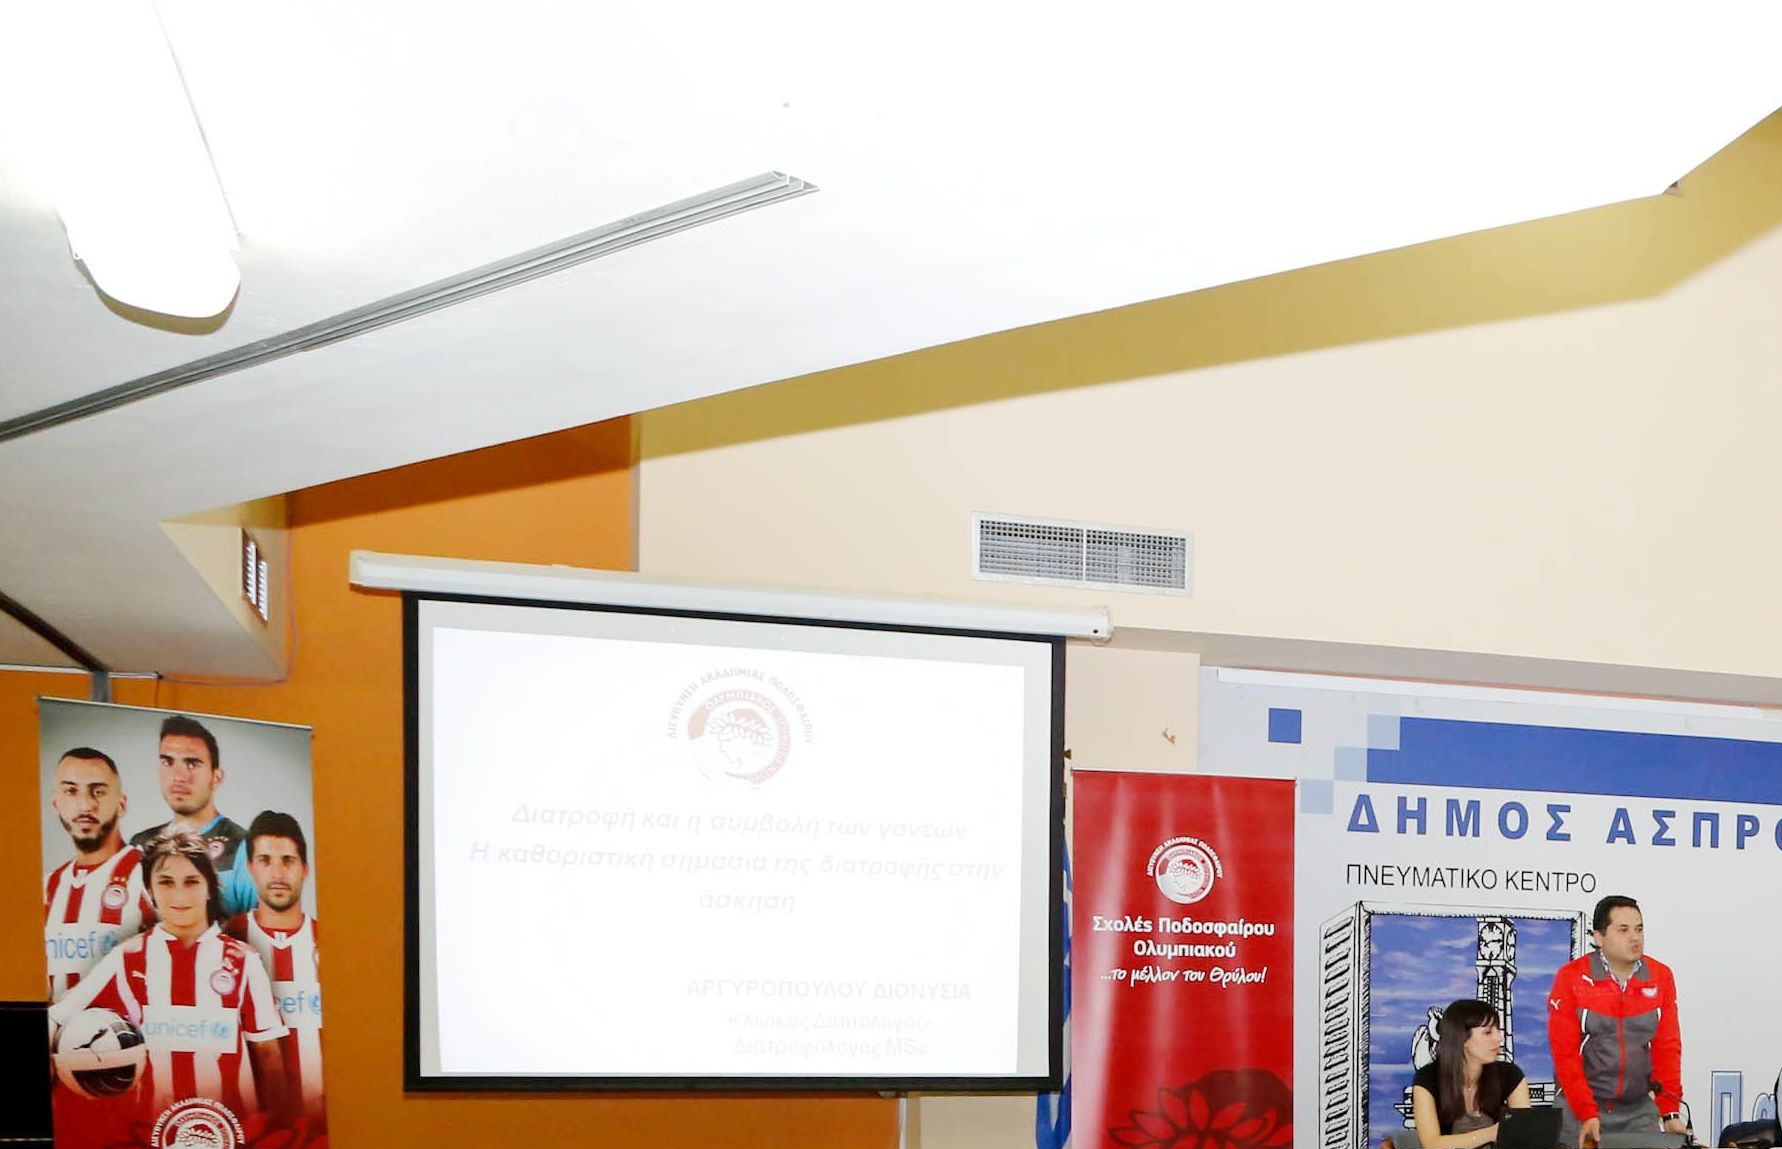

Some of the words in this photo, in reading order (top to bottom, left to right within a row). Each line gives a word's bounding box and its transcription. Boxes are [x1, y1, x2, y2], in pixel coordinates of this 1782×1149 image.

[642, 812, 679, 829] και
[1347, 794, 1571, 841] ΔΗΜΟΣ
[1346, 864, 1498, 890] ΠΝΕΥΜΑΤΙΚΟ
[1505, 870, 1597, 893] ΚΕΝΤΡΟ
[1092, 916, 1153, 932] Σχολές
[1158, 917, 1275, 938] Ποδοσφαίρου
[45, 931, 96, 959] nicef
[1133, 940, 1236, 959] Ολυμπιακού
[1130, 965, 1180, 987] μέλλον
[1183, 969, 1205, 982] του
[1209, 966, 1267, 988] Θρύλου!
[686, 979, 867, 999] ΑΡΓΥΡΟΠΟΥΛΟΥ
[873, 981, 972, 1000] ΔΙΟΝΥΣΙΑ
